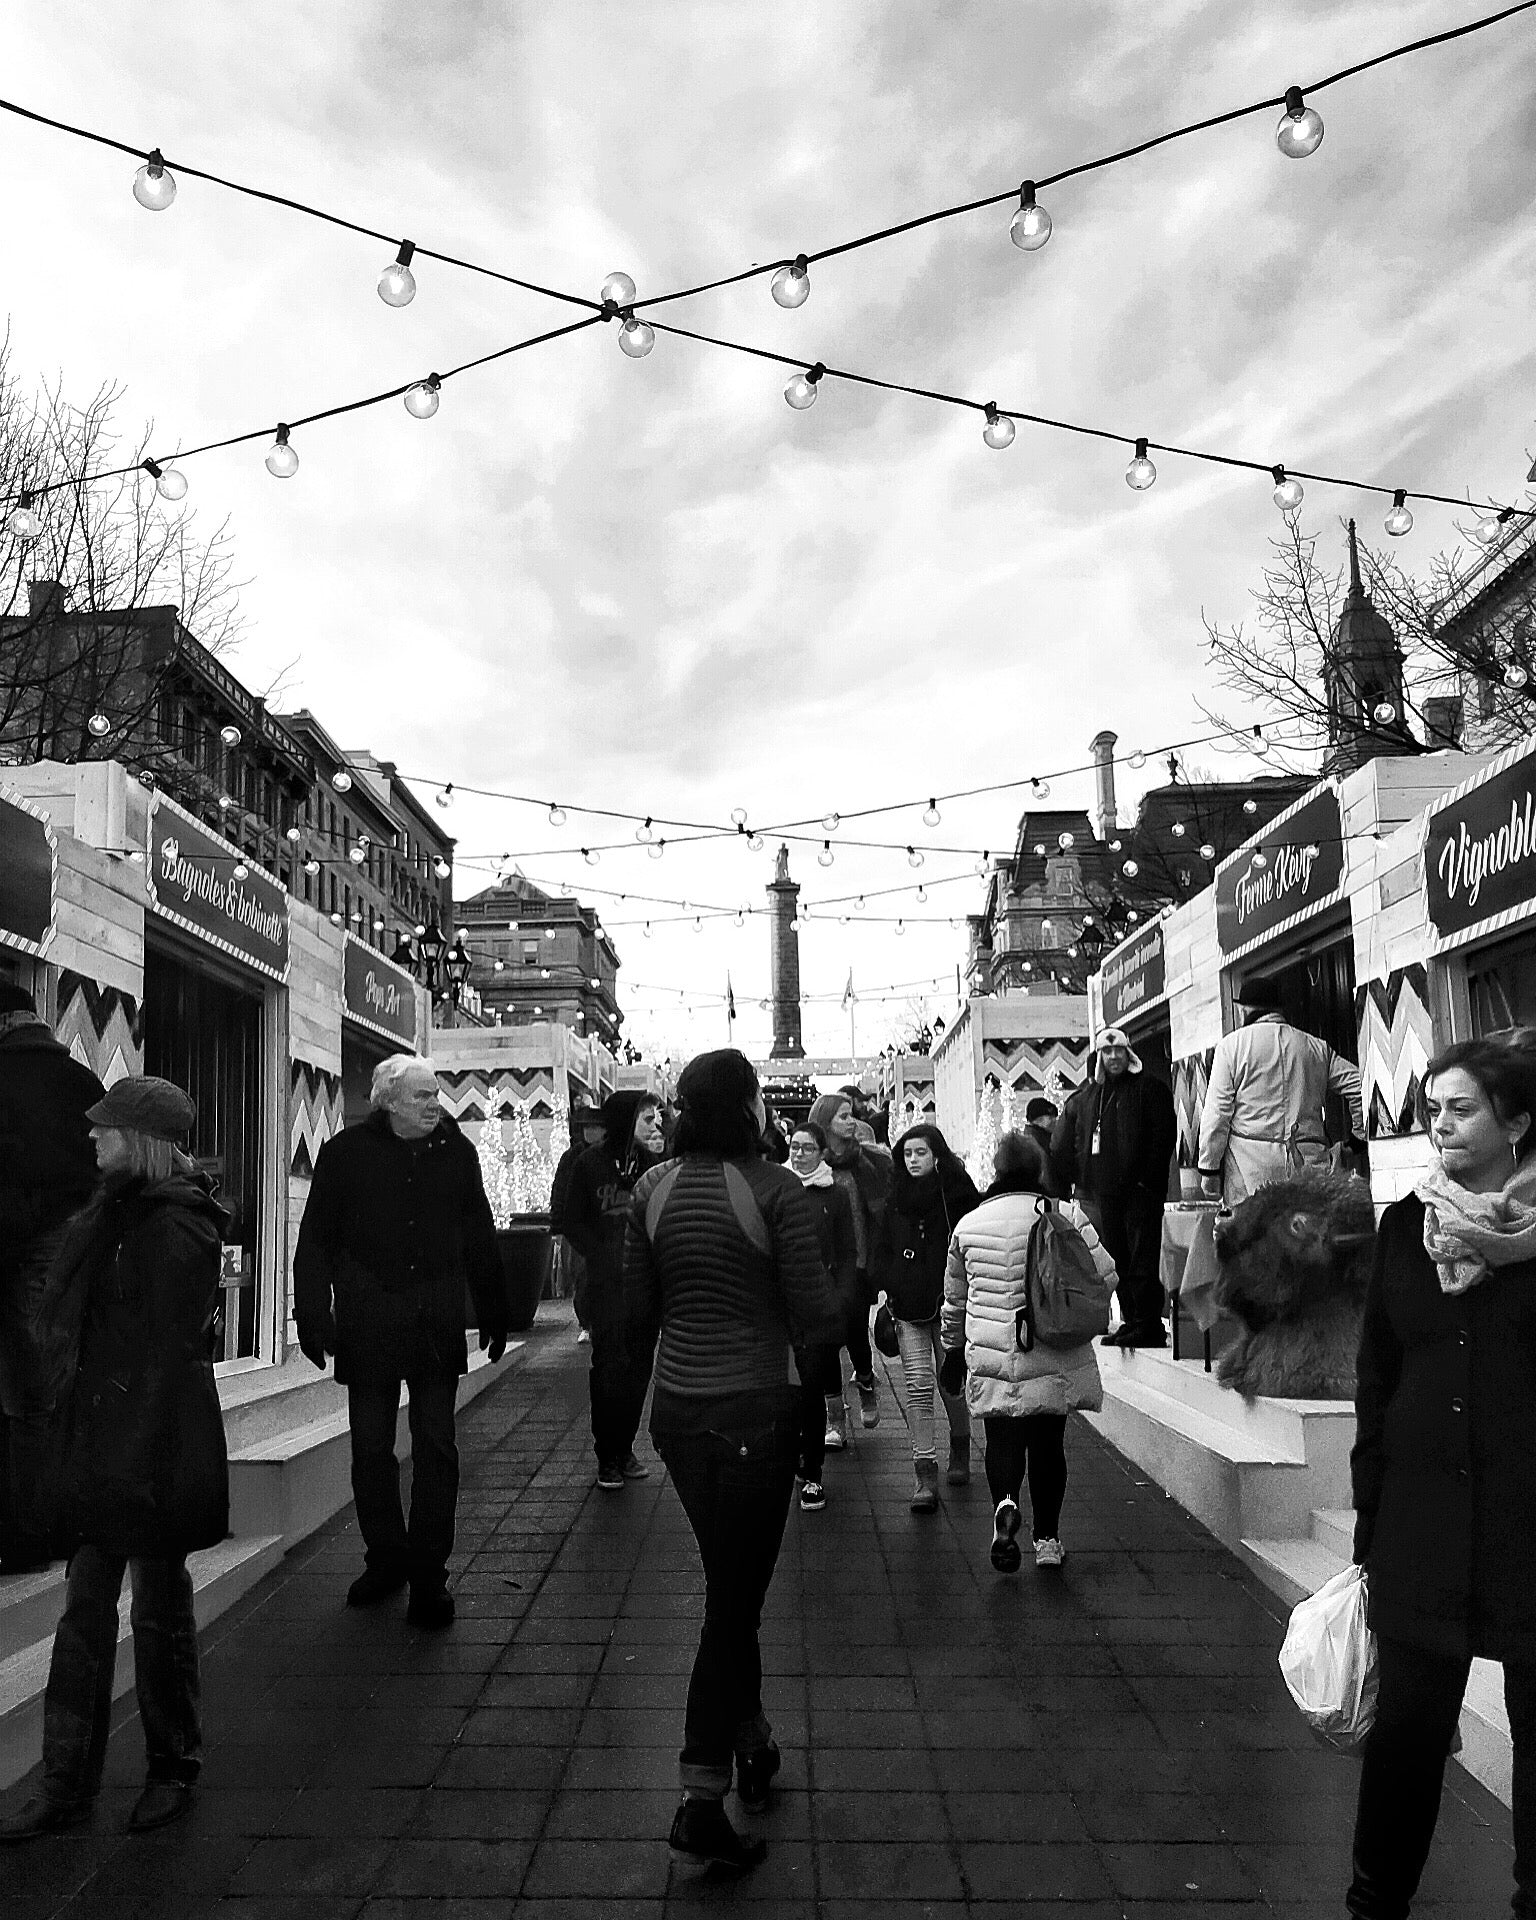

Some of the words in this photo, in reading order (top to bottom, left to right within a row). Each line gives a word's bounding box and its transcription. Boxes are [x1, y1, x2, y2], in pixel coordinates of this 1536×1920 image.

[161, 836, 226, 910] Bagnoles
[225, 878, 239, 921] &
[237, 885, 283, 946] bobinette
[1234, 863, 1274, 925] Ferme
